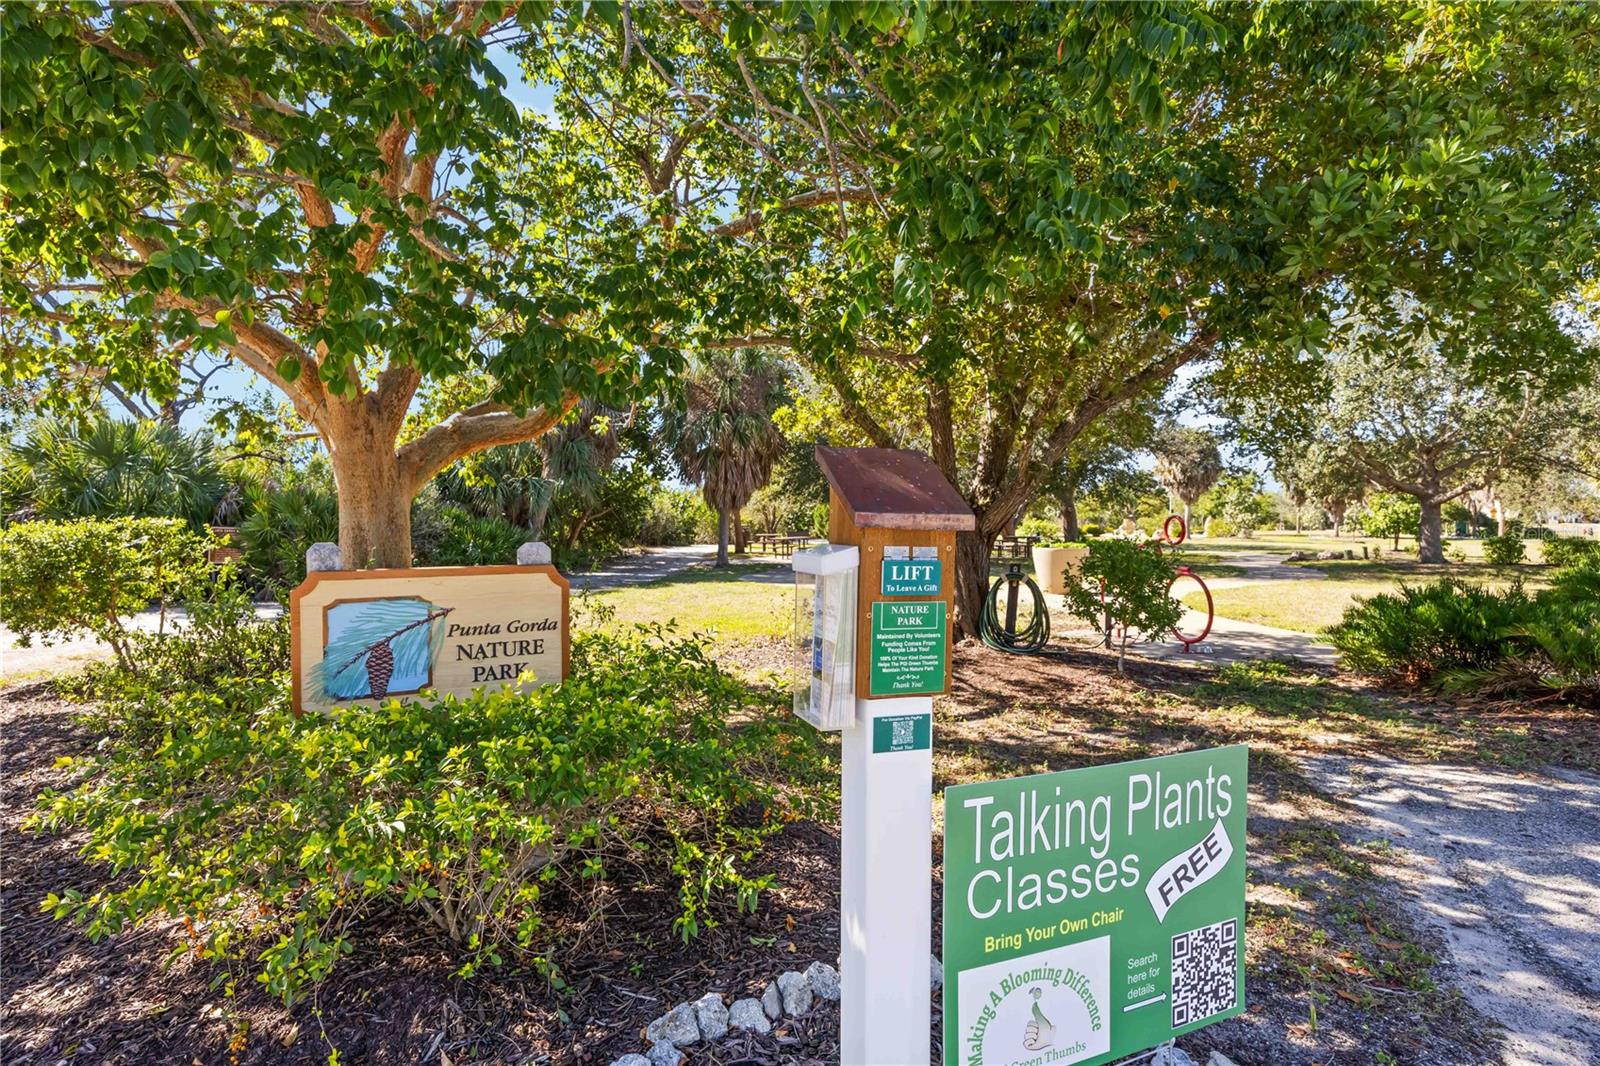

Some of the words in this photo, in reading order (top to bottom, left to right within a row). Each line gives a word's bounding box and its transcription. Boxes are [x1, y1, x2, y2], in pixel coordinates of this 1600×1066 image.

[891, 565, 934, 581] LIFT
[917, 584, 923, 592] A
[923, 584, 938, 592] Gift
[891, 605, 929, 614] NATURE
[446, 623, 501, 638] Punta
[507, 618, 558, 633] Gorda
[897, 616, 923, 626] PARK
[456, 638, 545, 661] NATURE
[472, 662, 529, 682] PARK
[964, 786, 1112, 864] Talking
[1128, 765, 1232, 836] Plants
[1157, 832, 1223, 907] FREE
[967, 853, 1140, 919] Classes
[984, 933, 1022, 953] Bring
[1025, 925, 1057, 943] Your
[1059, 918, 1088, 935] Own
[1091, 907, 1125, 926] Chair
[1127, 952, 1158, 970] Search
[1127, 971, 1147, 985] here
[1148, 967, 1161, 979] for
[1127, 982, 1156, 1000] details
[967, 1004, 997, 1066] Making
[989, 990, 1003, 1008] A
[999, 961, 1063, 997] Blooming
[1062, 968, 1102, 1032] Difference
[1044, 1041, 1087, 1063] Thumbs
